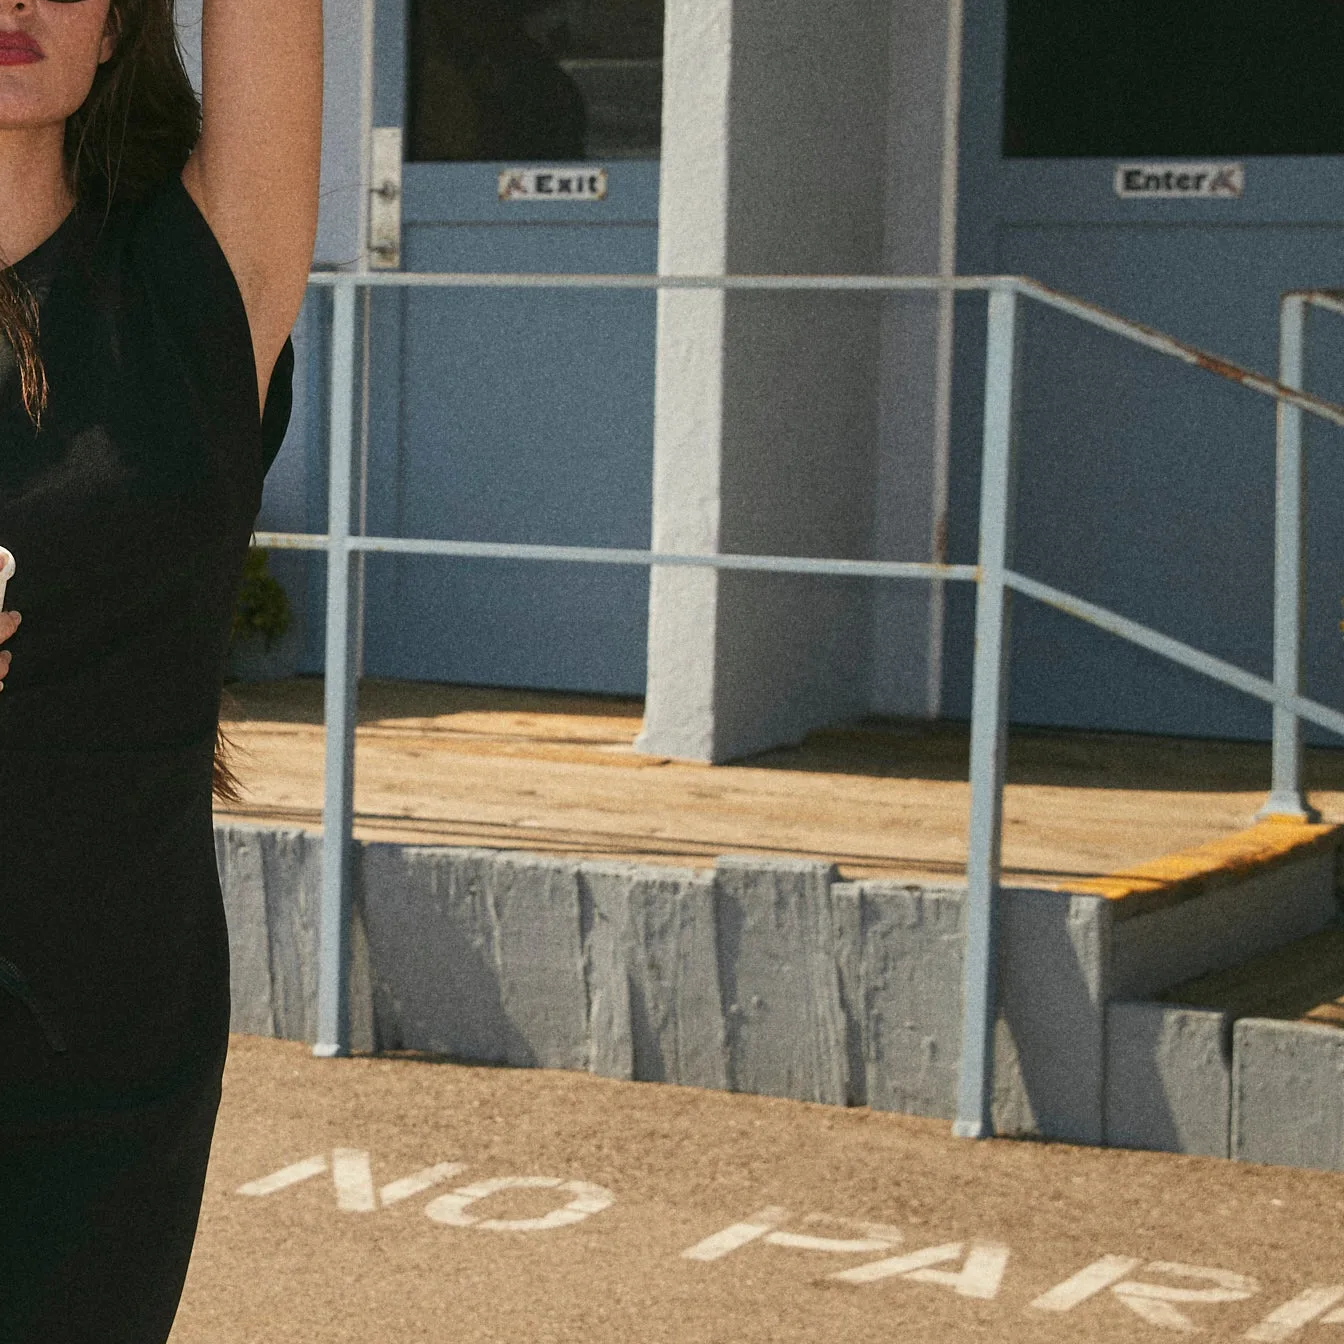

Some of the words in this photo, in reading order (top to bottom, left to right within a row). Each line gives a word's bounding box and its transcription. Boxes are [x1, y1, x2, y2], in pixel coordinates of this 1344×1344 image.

[535, 174, 597, 193] Exit
[1123, 169, 1209, 191] Enter
[234, 1148, 616, 1230] NO
